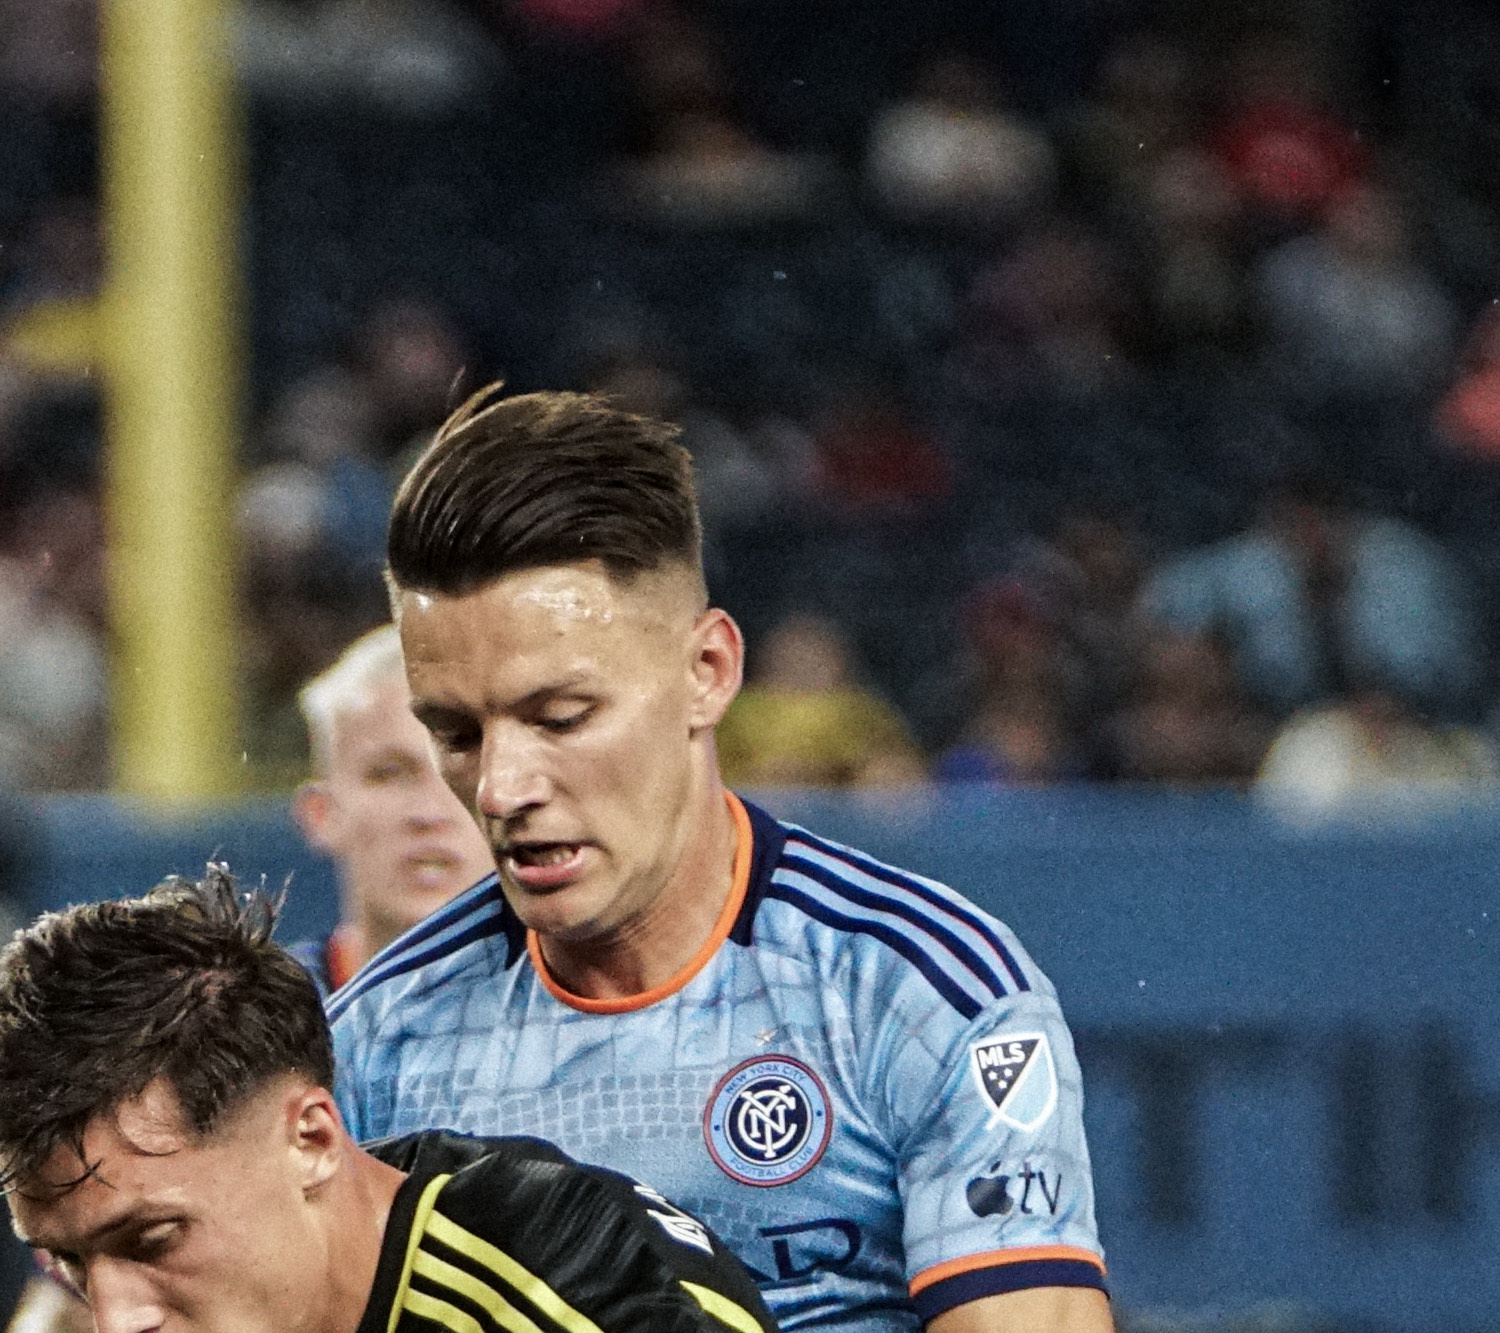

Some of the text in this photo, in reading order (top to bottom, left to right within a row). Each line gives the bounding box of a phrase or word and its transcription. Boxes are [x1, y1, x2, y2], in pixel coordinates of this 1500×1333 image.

[978, 1042, 1026, 1070] MLS
[725, 1063, 808, 1095] NEW YORK CITY
[730, 1146, 813, 1178] FOOTBALL CLUB
[1017, 1161, 1062, 1216] tv
